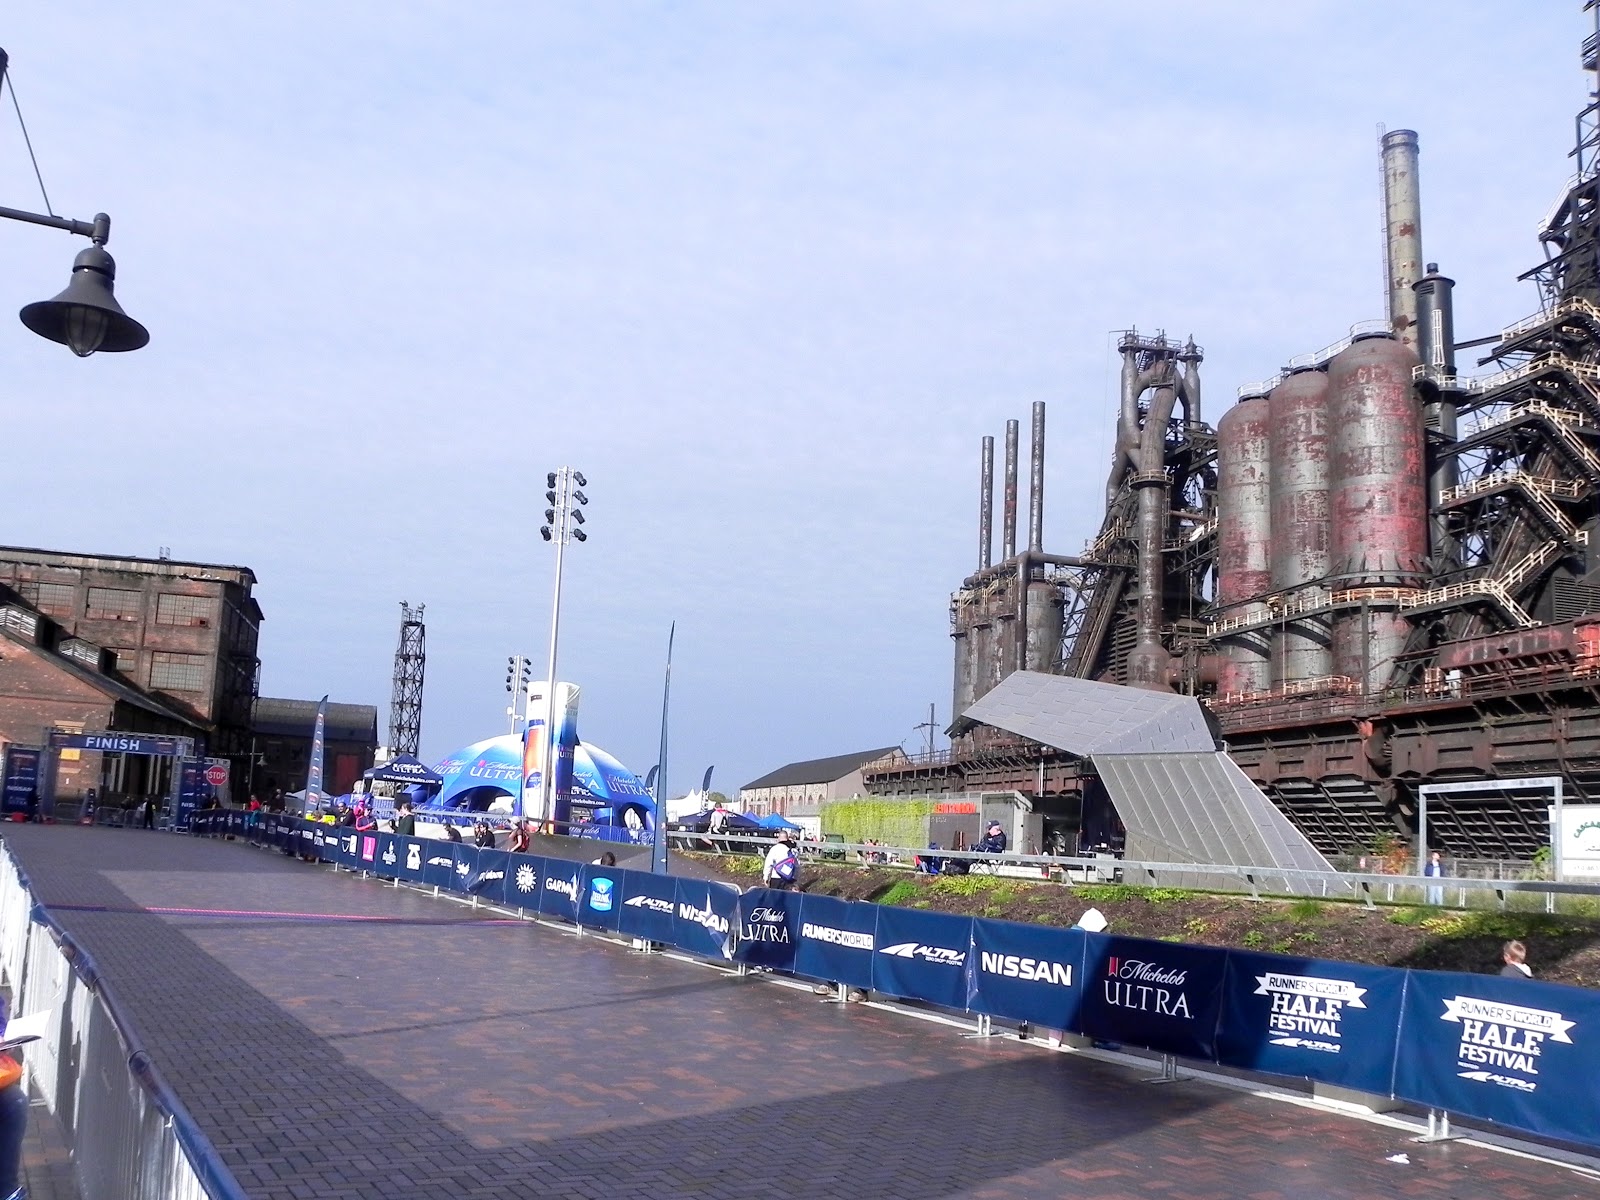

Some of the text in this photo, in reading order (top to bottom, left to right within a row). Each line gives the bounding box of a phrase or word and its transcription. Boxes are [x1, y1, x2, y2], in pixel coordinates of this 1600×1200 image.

[85, 736, 140, 751] FINISH
[208, 771, 226, 780] STOP
[393, 766, 427, 774] ULTRA
[606, 780, 647, 796] ULTRA
[518, 870, 534, 885] GU
[738, 923, 790, 944] ULTRA
[843, 932, 873, 948] WORLD
[913, 945, 966, 962] ALTRA
[981, 951, 1073, 987] NISSAN
[1119, 959, 1188, 985] Michelob
[1269, 976, 1314, 992] RUNNERS
[1104, 980, 1192, 1019] ULTRA
[1271, 992, 1343, 1020] HALF
[1460, 1001, 1553, 1028] RUNNERS WORLD
[1269, 1013, 1342, 1038] FESTIVAL
[1461, 1019, 1545, 1055] HALF
[1459, 1042, 1539, 1075] FESTIVAL
